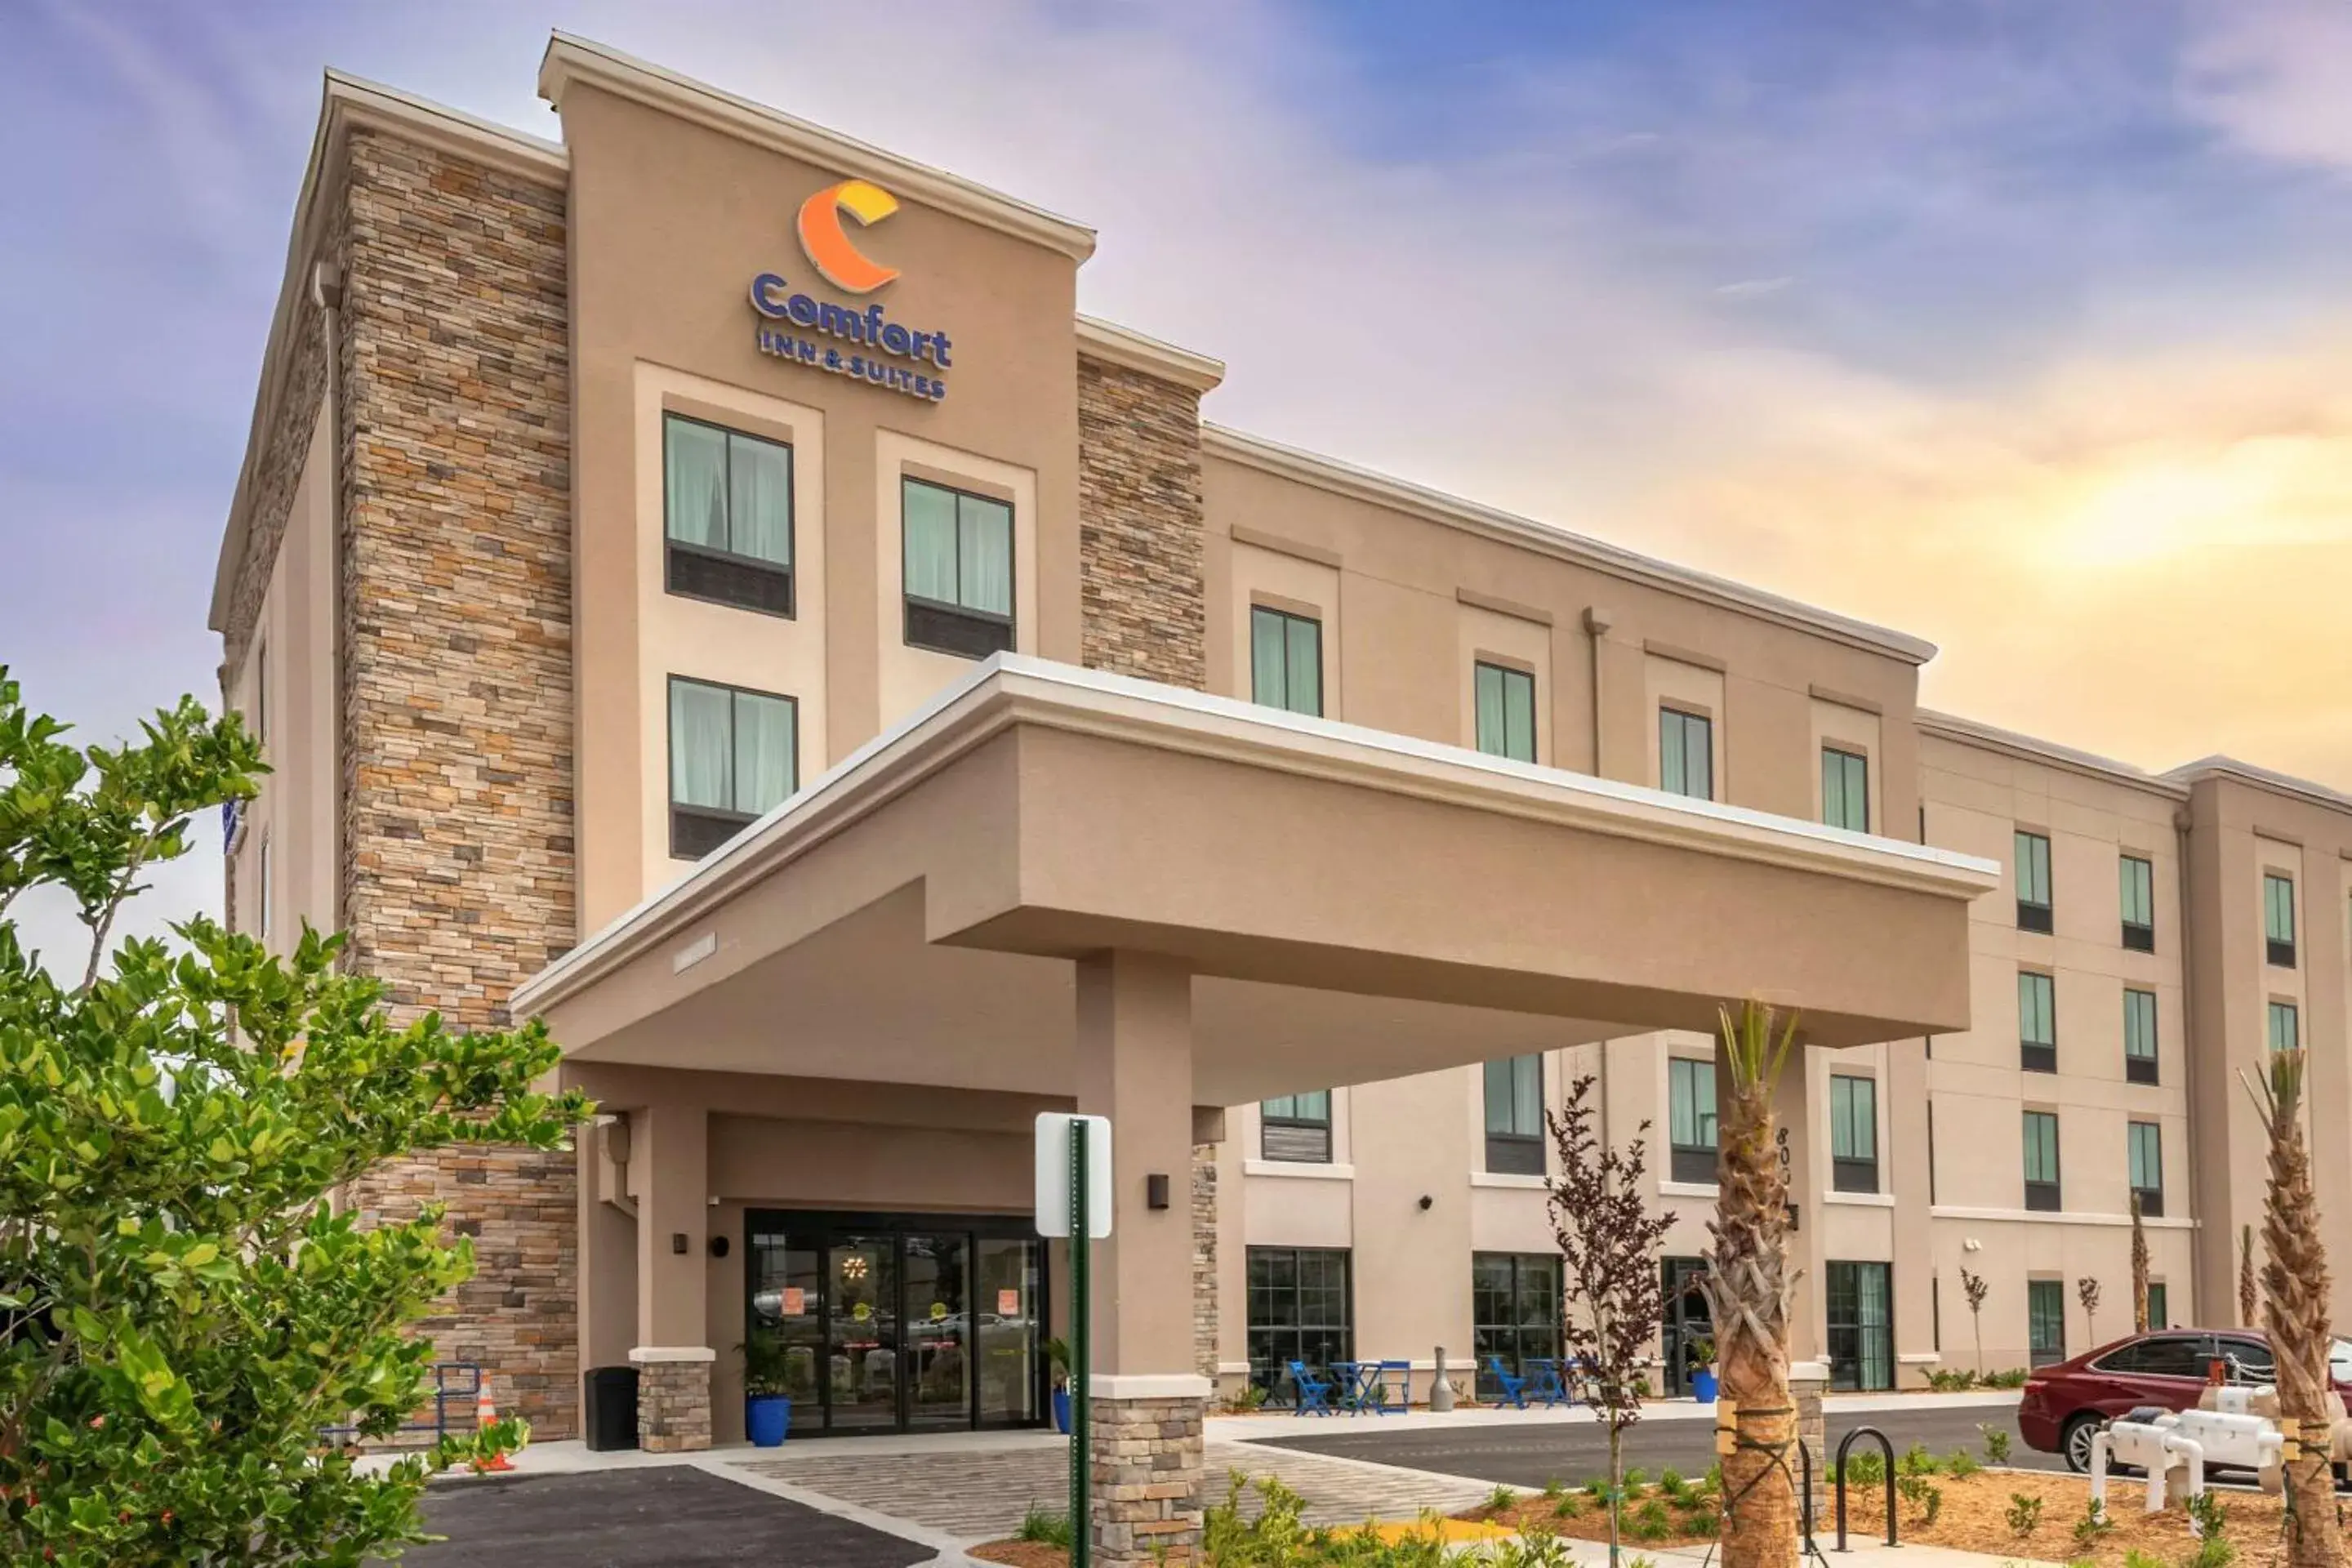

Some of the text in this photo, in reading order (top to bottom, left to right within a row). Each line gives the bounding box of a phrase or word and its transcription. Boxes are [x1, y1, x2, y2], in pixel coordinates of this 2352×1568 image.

[751, 272, 952, 369] Comfort
[760, 329, 946, 402] INN & SUITES
